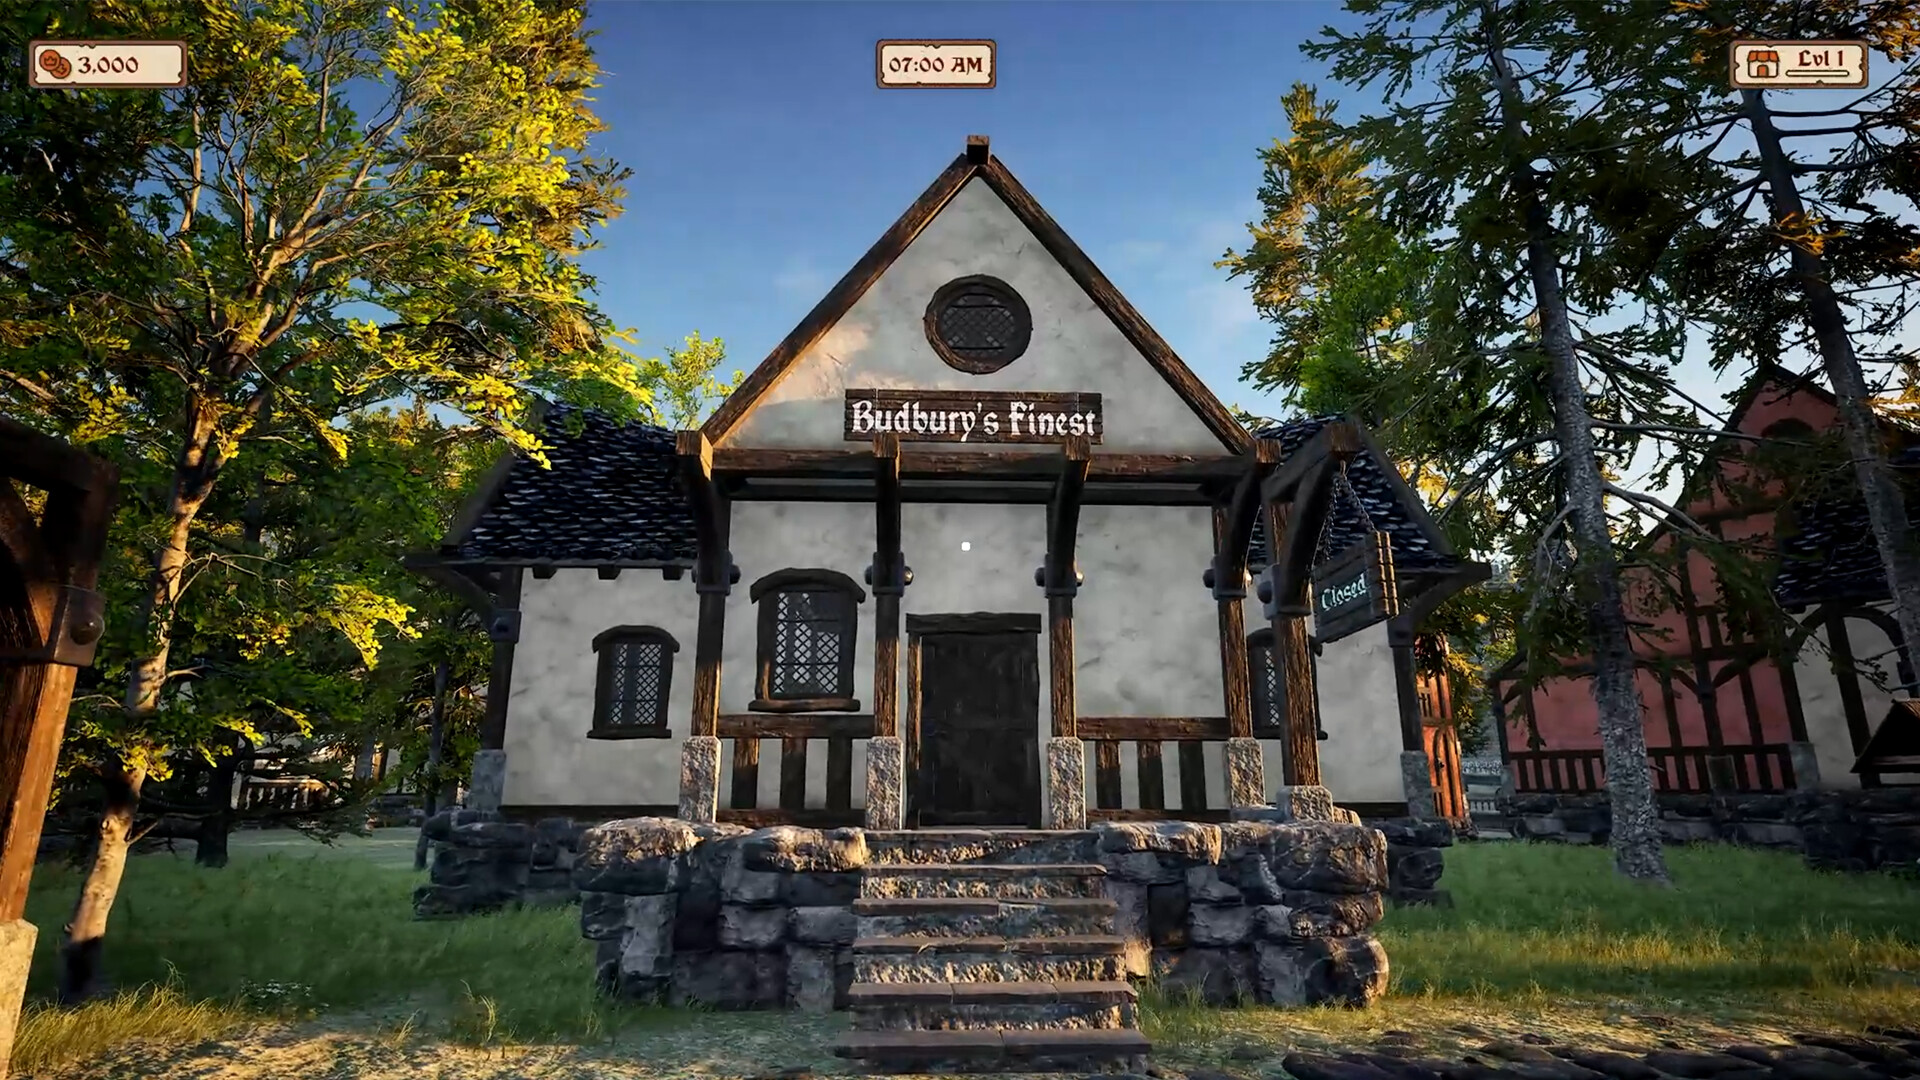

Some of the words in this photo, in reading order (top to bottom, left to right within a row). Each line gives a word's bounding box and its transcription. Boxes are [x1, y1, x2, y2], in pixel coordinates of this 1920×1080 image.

[852, 400, 1000, 442] Budbury's
[1008, 401, 1096, 436] Finest
[1321, 573, 1367, 611] Closed
